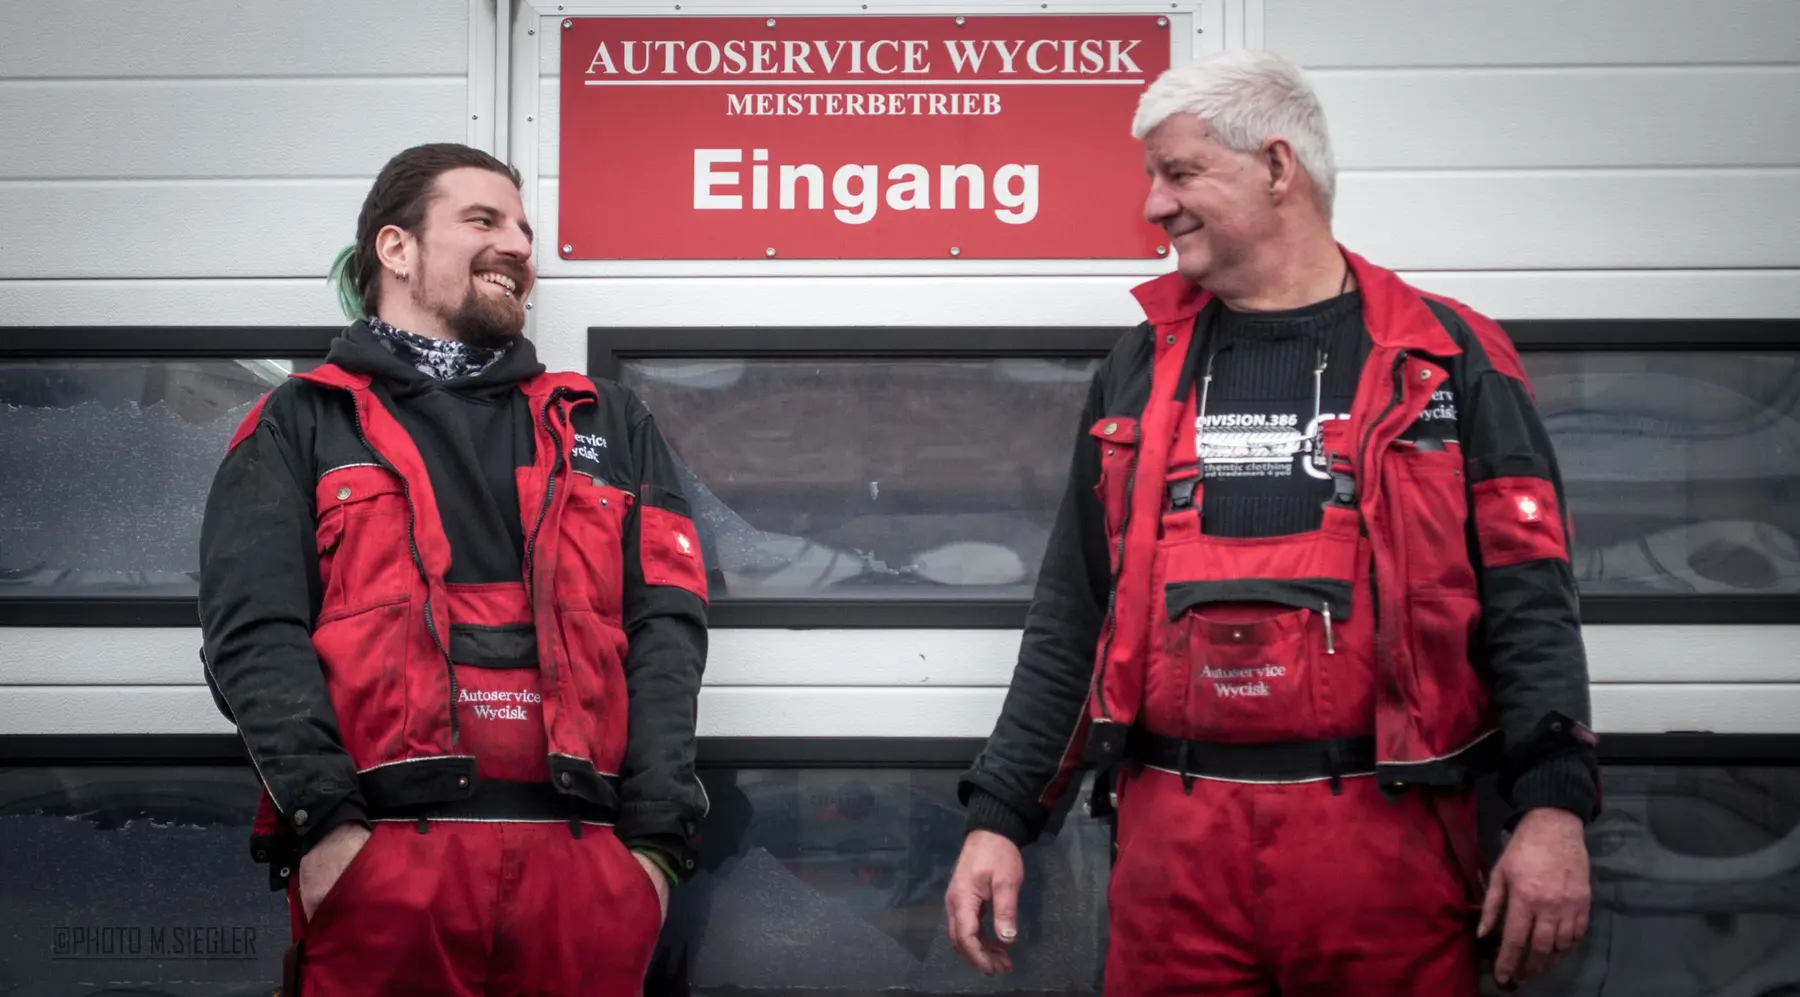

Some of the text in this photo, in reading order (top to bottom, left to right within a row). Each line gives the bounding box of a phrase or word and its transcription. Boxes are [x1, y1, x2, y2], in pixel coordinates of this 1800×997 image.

[585, 39, 1143, 75] AUTOSERVICE WYCISK
[726, 93, 1002, 116] MEISTERBETRIEB
[693, 148, 1040, 225] Eingang
[1195, 413, 1298, 427] DIVISION.386
[574, 433, 608, 448] ervice
[571, 446, 600, 463] ycisk
[1246, 463, 1292, 472] clothing
[1200, 664, 1286, 678] Autoservice
[458, 688, 541, 703] Autoservice
[1214, 681, 1270, 698] Wycisk
[474, 705, 528, 720] Wycisk
